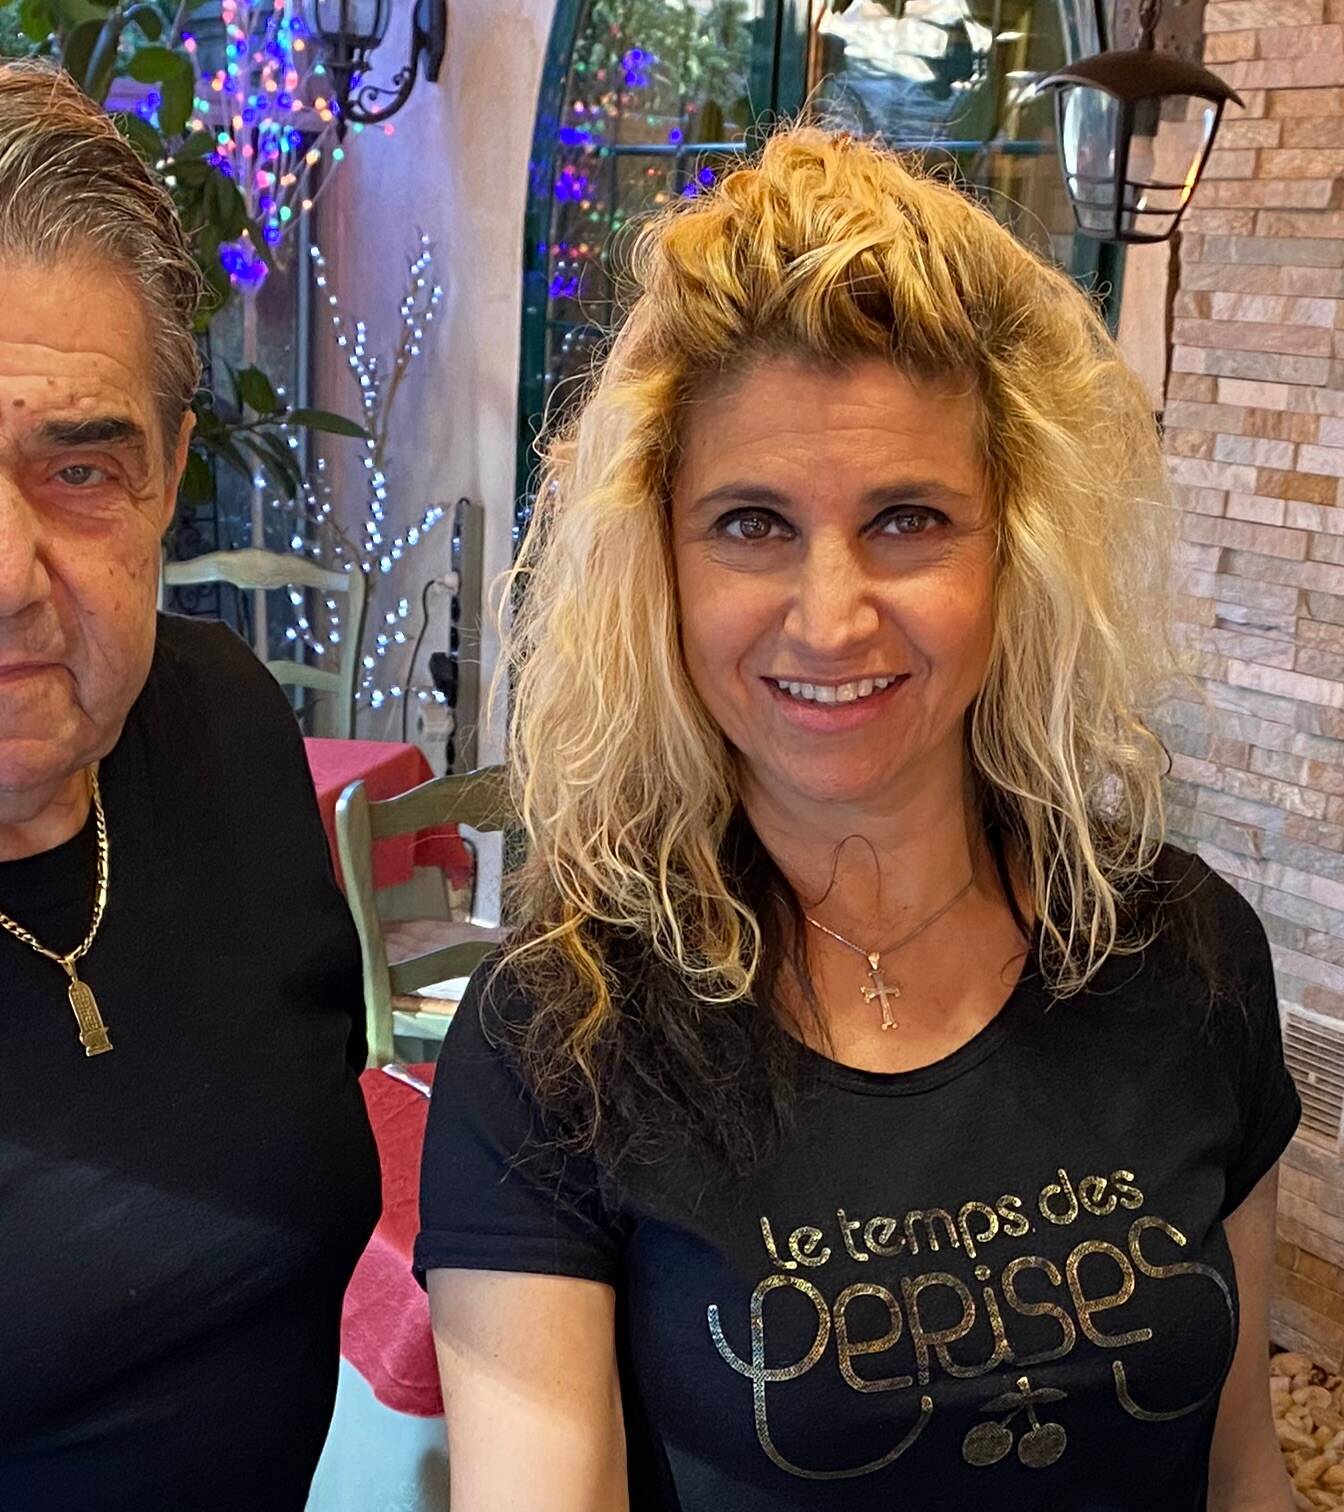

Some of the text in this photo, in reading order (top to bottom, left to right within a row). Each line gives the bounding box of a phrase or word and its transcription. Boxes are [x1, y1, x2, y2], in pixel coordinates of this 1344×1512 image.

[760, 1168, 1145, 1270] le temps des
